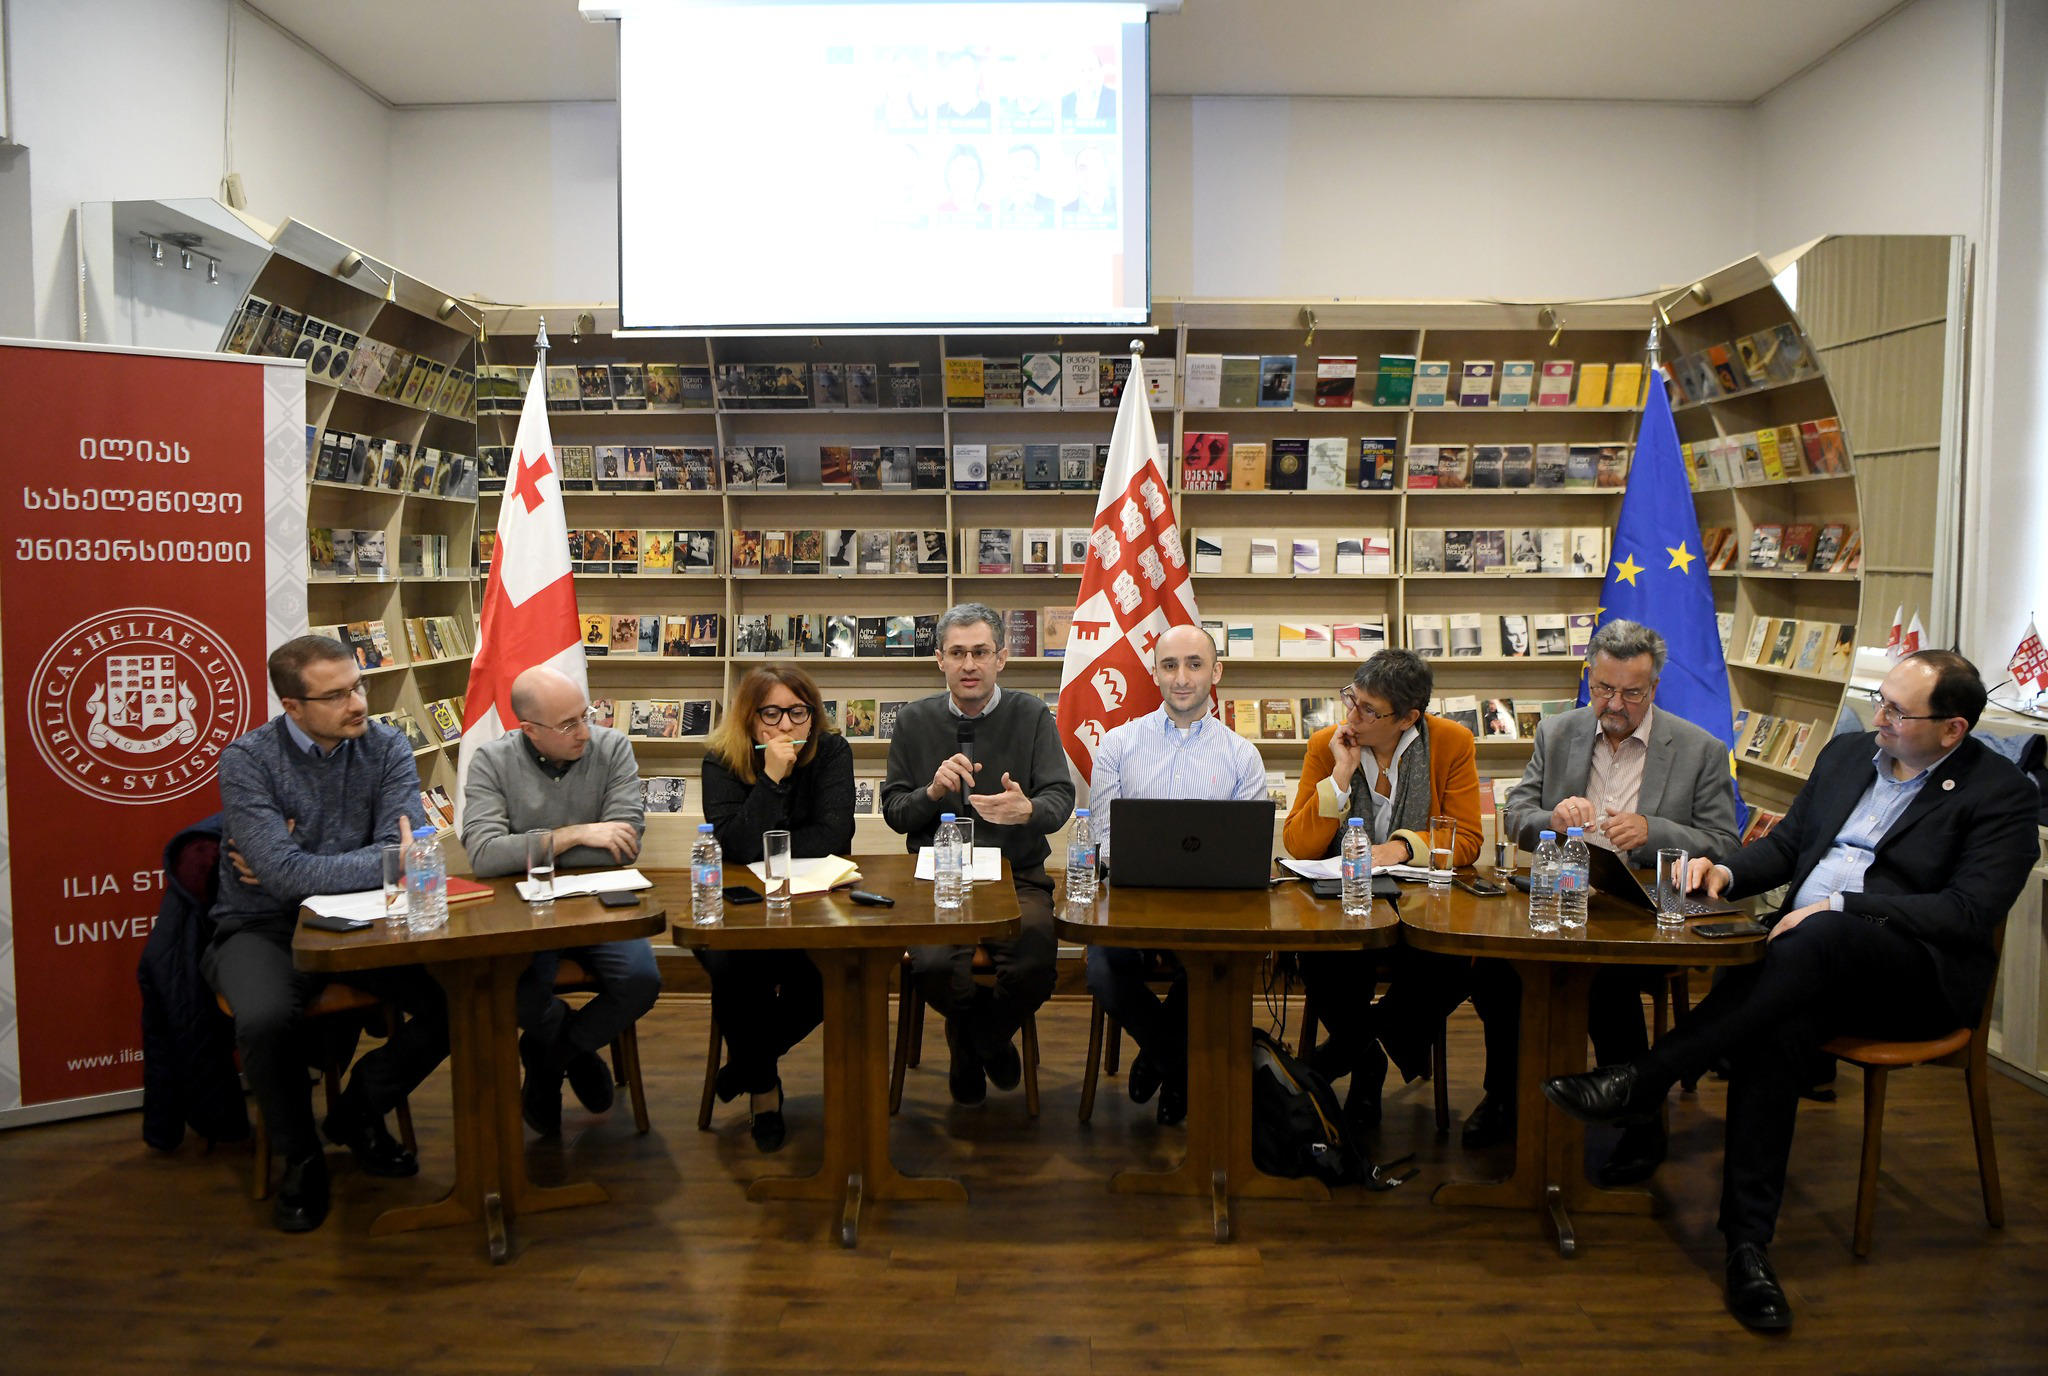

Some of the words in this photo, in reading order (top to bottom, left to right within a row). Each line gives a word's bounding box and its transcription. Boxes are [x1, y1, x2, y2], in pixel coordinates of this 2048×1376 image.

[79, 437, 191, 463] ილიას
[23, 487, 243, 514] სახელმწიფო
[16, 538, 251, 563] უნივერსიტეტი
[86, 622, 196, 650] HELIAE
[45, 664, 95, 776] PUBLICA
[123, 657, 236, 790] UNIVERSITAS
[63, 874, 120, 898] ILIA
[132, 869, 166, 892] ST
[67, 1049, 145, 1071] www.ilia
